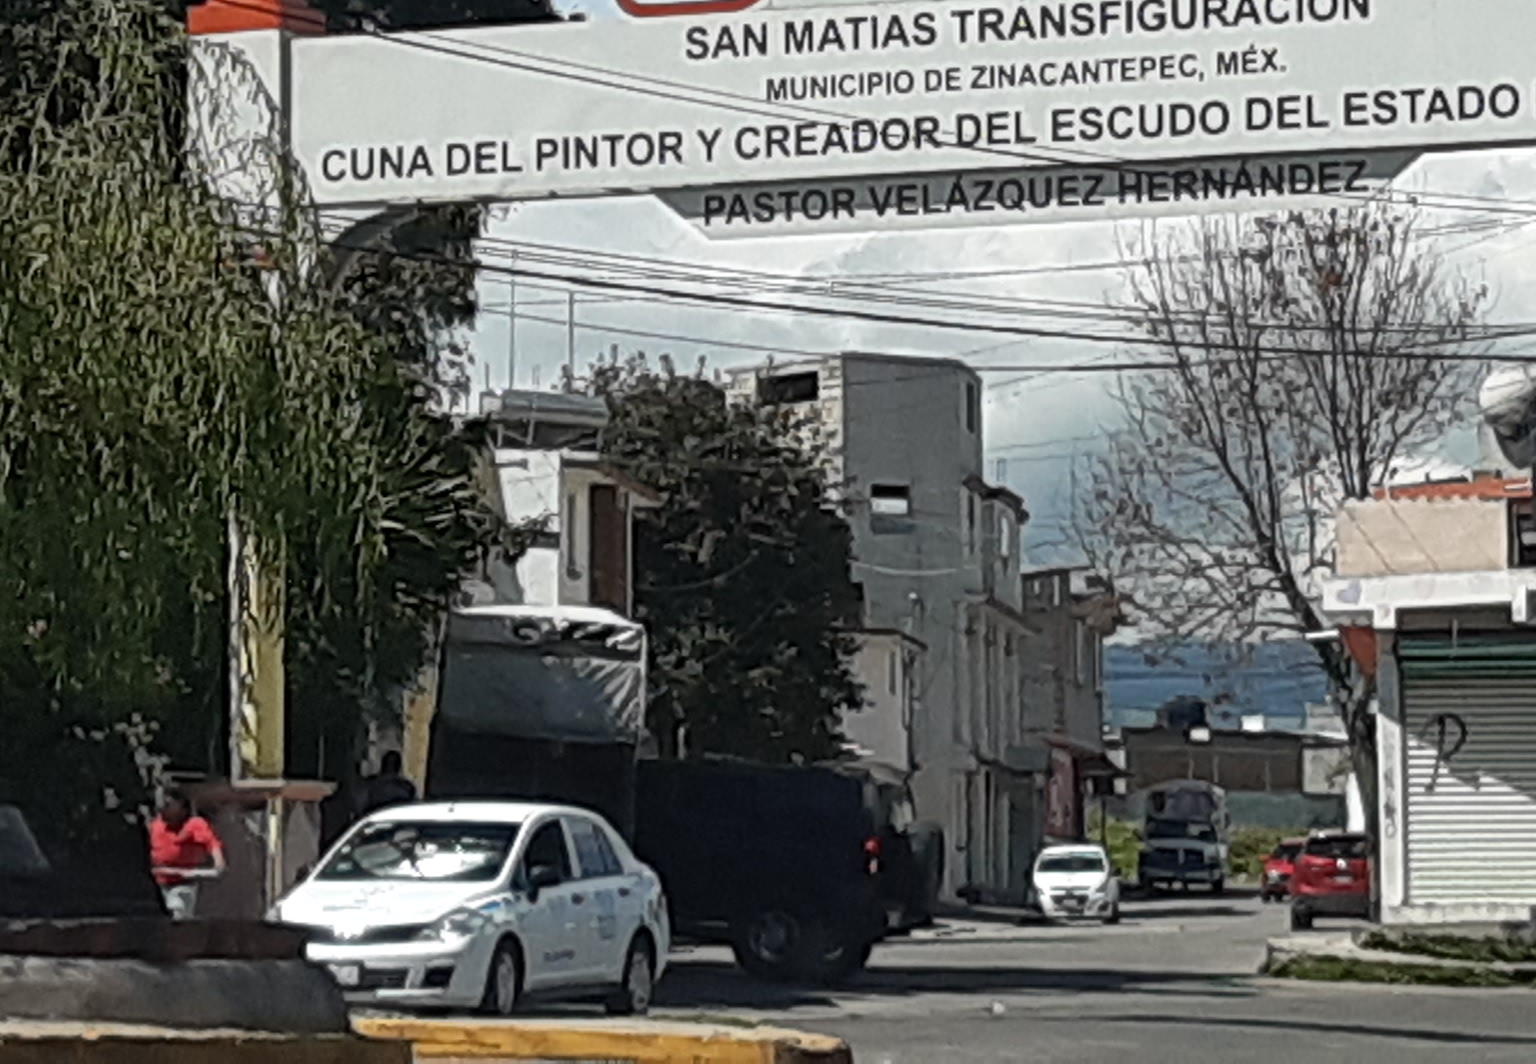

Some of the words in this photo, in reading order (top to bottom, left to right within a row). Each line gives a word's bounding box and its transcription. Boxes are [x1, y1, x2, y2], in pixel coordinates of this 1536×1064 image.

[685, 25, 768, 60] SAN
[784, 13, 938, 54] MATIAS
[766, 70, 915, 102] MUNICIPIO
[925, 66, 962, 94] DE
[970, 54, 1205, 91] ZINACANTEPEC,
[1215, 45, 1289, 76] MÉX.
[322, 145, 432, 182] CUNA
[446, 141, 523, 176] DEL
[536, 132, 684, 171] PINTOR
[696, 129, 722, 161] Y
[734, 118, 944, 159] CREADOR
[955, 110, 1039, 148] DEL
[1051, 101, 1230, 142] ESCUDO
[1245, 94, 1330, 132] DEL
[1343, 82, 1522, 128] ESTADO
[703, 189, 856, 225] PASTOR
[868, 173, 1103, 217] VELÁZQUEZ
[1118, 158, 1368, 204] HERNÁNDEZ
